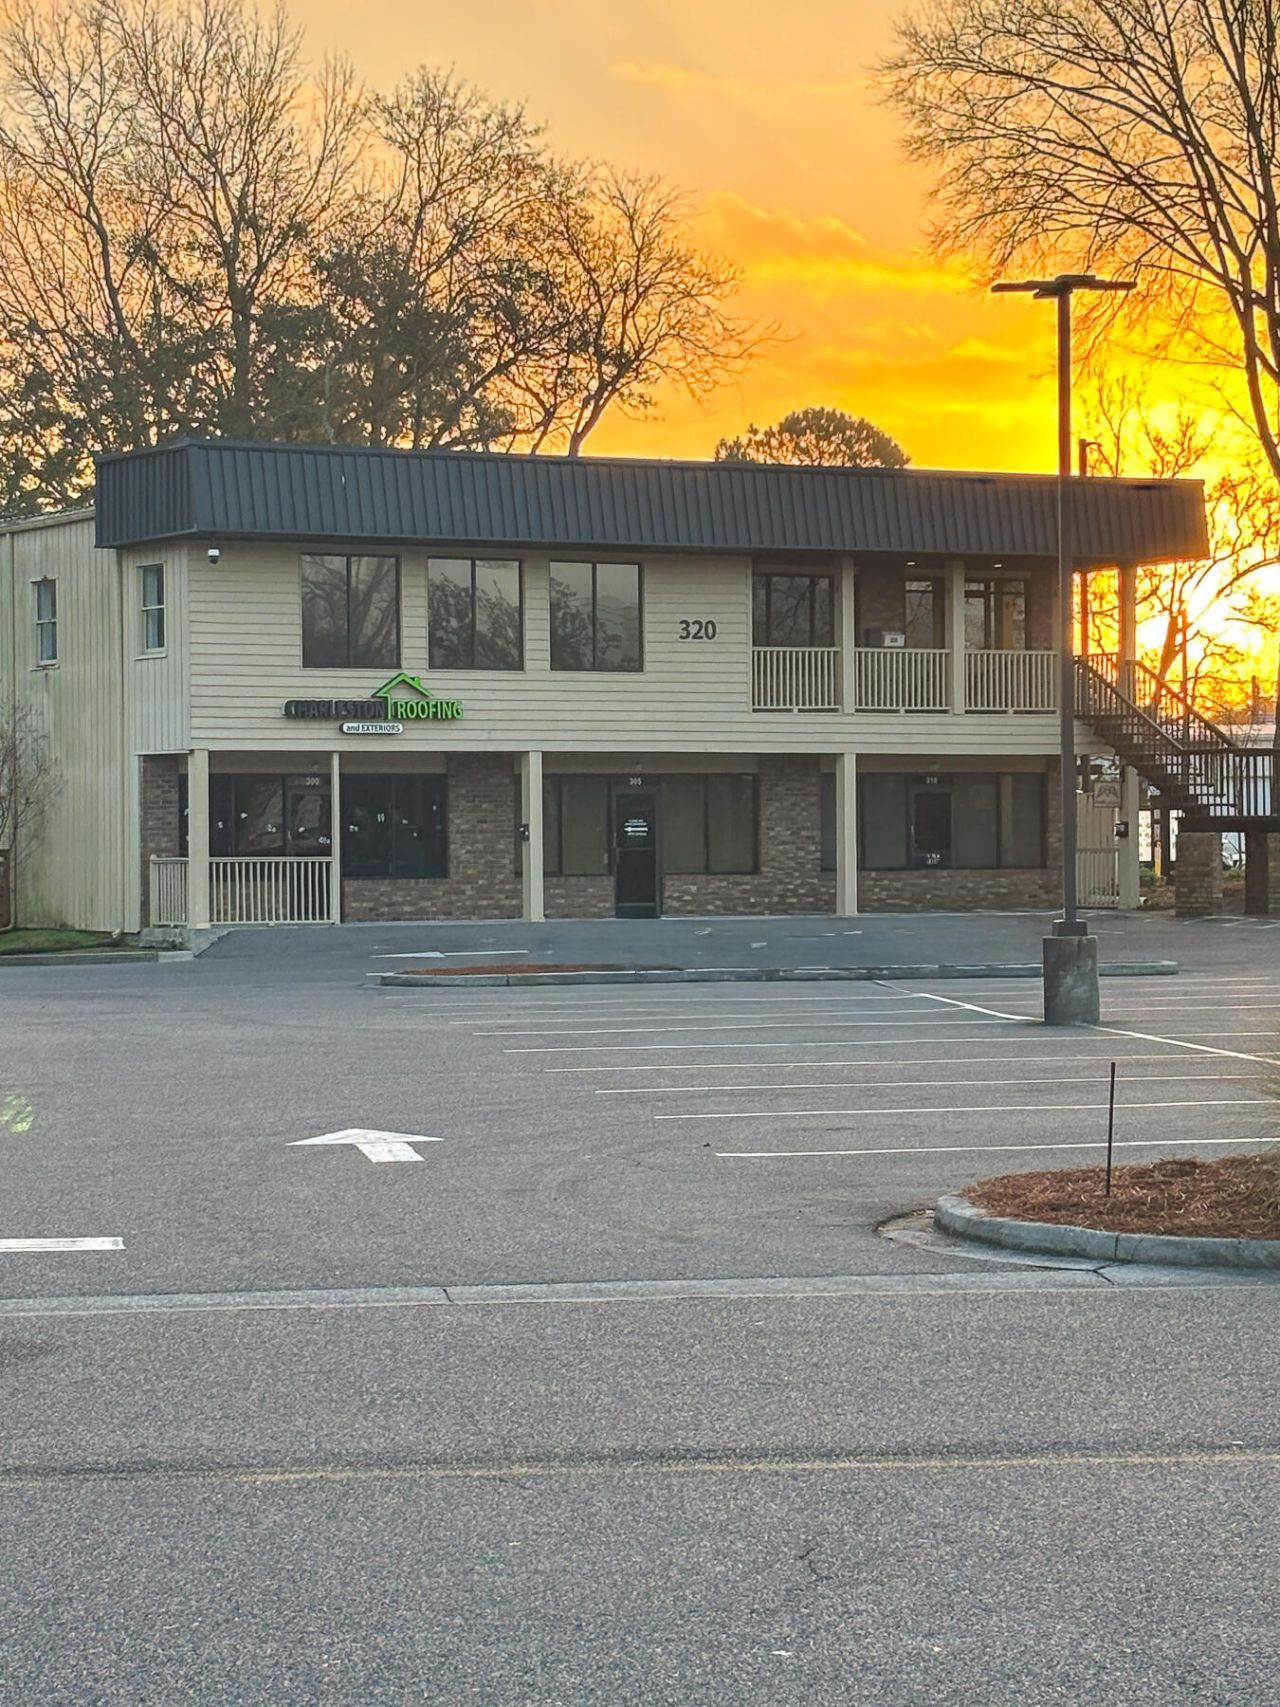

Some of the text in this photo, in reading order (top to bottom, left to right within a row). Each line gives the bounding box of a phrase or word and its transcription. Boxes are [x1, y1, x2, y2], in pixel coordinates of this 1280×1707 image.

[679, 619, 717, 641] 320
[396, 700, 464, 720] ROOFING
[346, 723, 401, 733] and EXTERIORS
